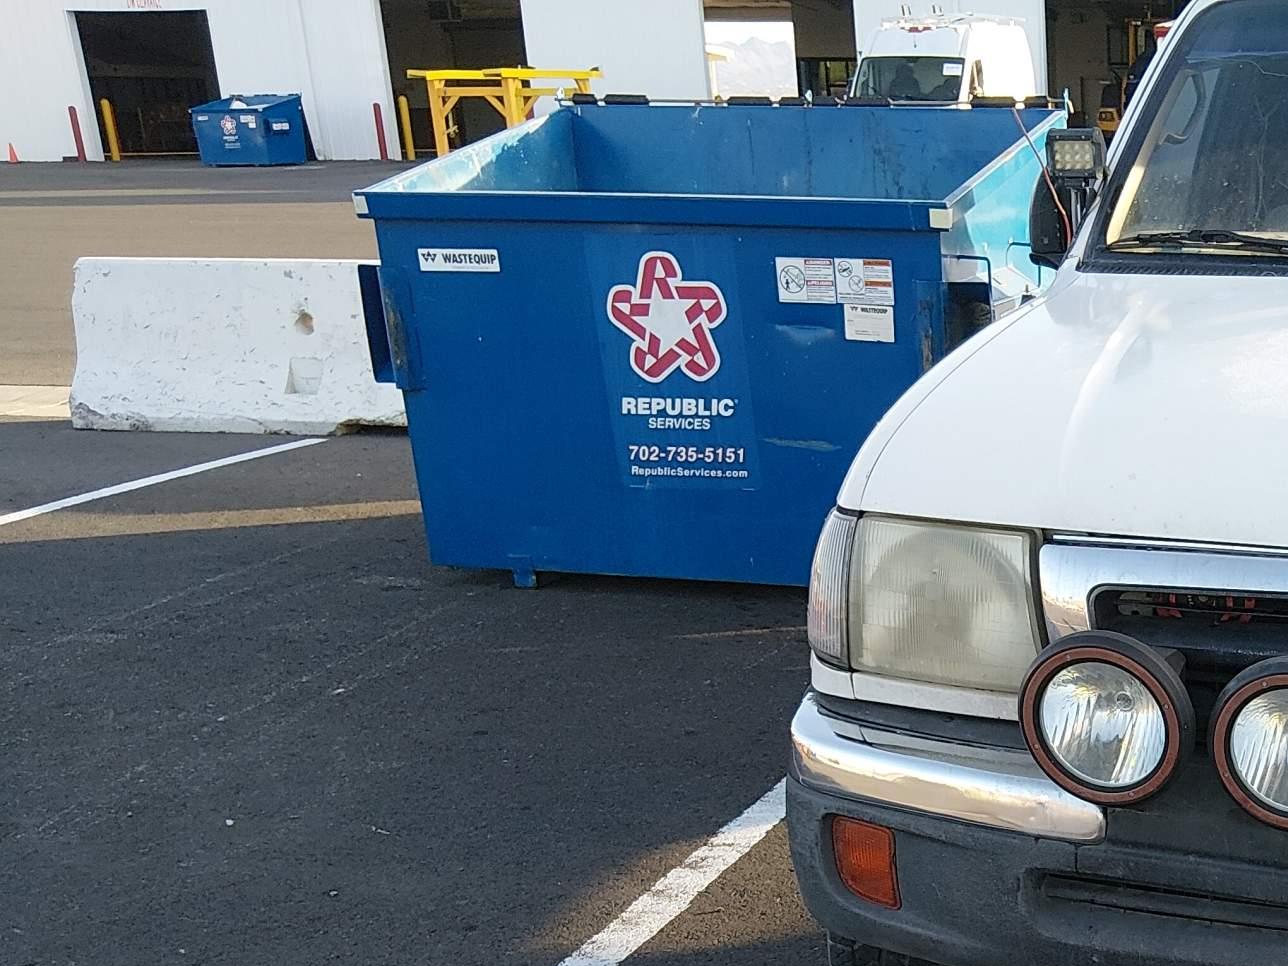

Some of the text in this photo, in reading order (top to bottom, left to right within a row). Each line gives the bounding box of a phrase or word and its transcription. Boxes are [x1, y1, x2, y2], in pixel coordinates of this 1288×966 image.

[442, 253, 496, 265] WASTEQUIP
[622, 397, 735, 417] REPUBLIC
[648, 418, 711, 430] SERVICES
[628, 446, 745, 463] 702-735-5151
[631, 465, 748, 479] RepublicServices.com
